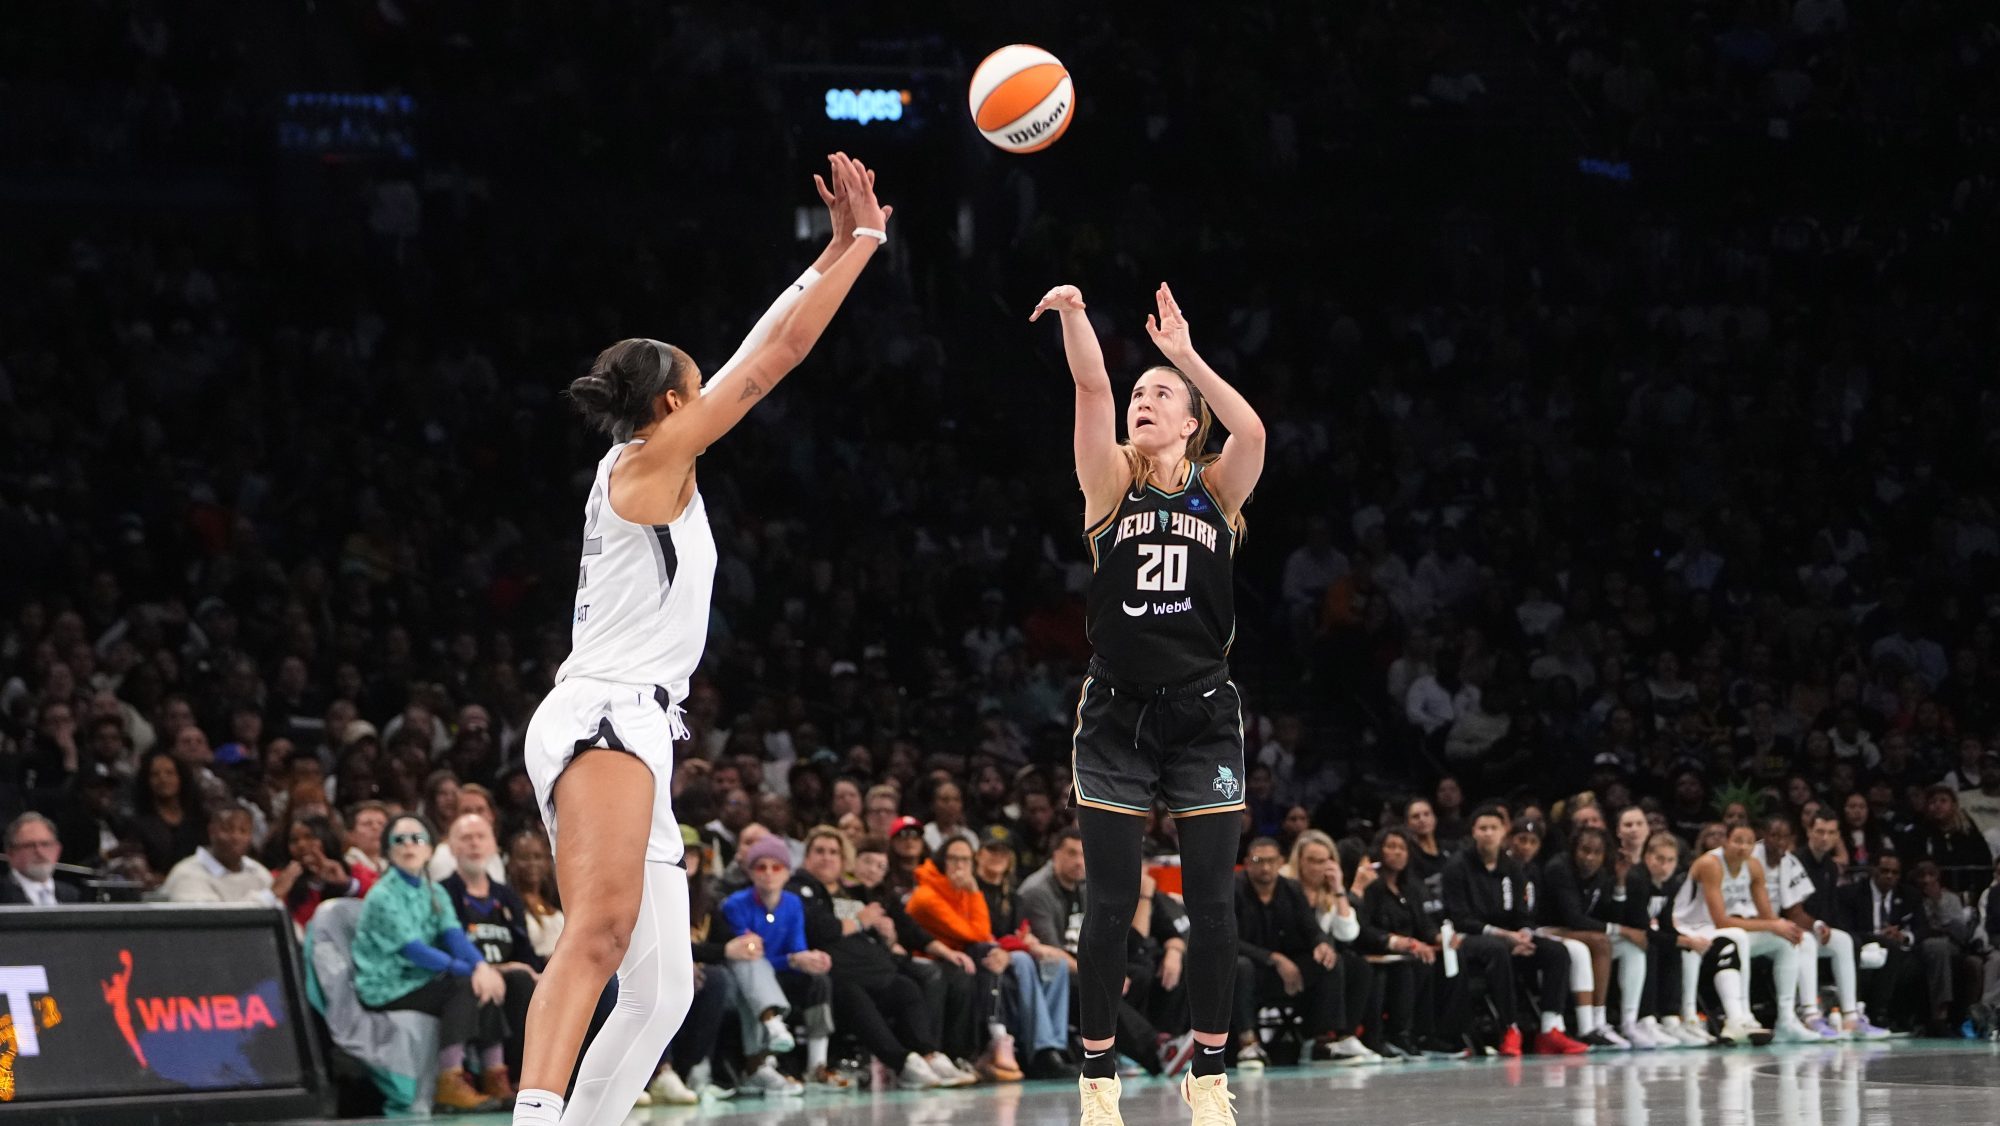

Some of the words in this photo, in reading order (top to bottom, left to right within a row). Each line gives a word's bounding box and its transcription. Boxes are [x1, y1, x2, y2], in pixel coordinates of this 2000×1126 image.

[1005, 102, 1066, 144] Wilson
[1114, 511, 1156, 548] NEW
[1171, 511, 1218, 554] YORK
[1136, 543, 1189, 592] 20
[1152, 597, 1193, 615] Webull
[135, 994, 278, 1032] WNBA
